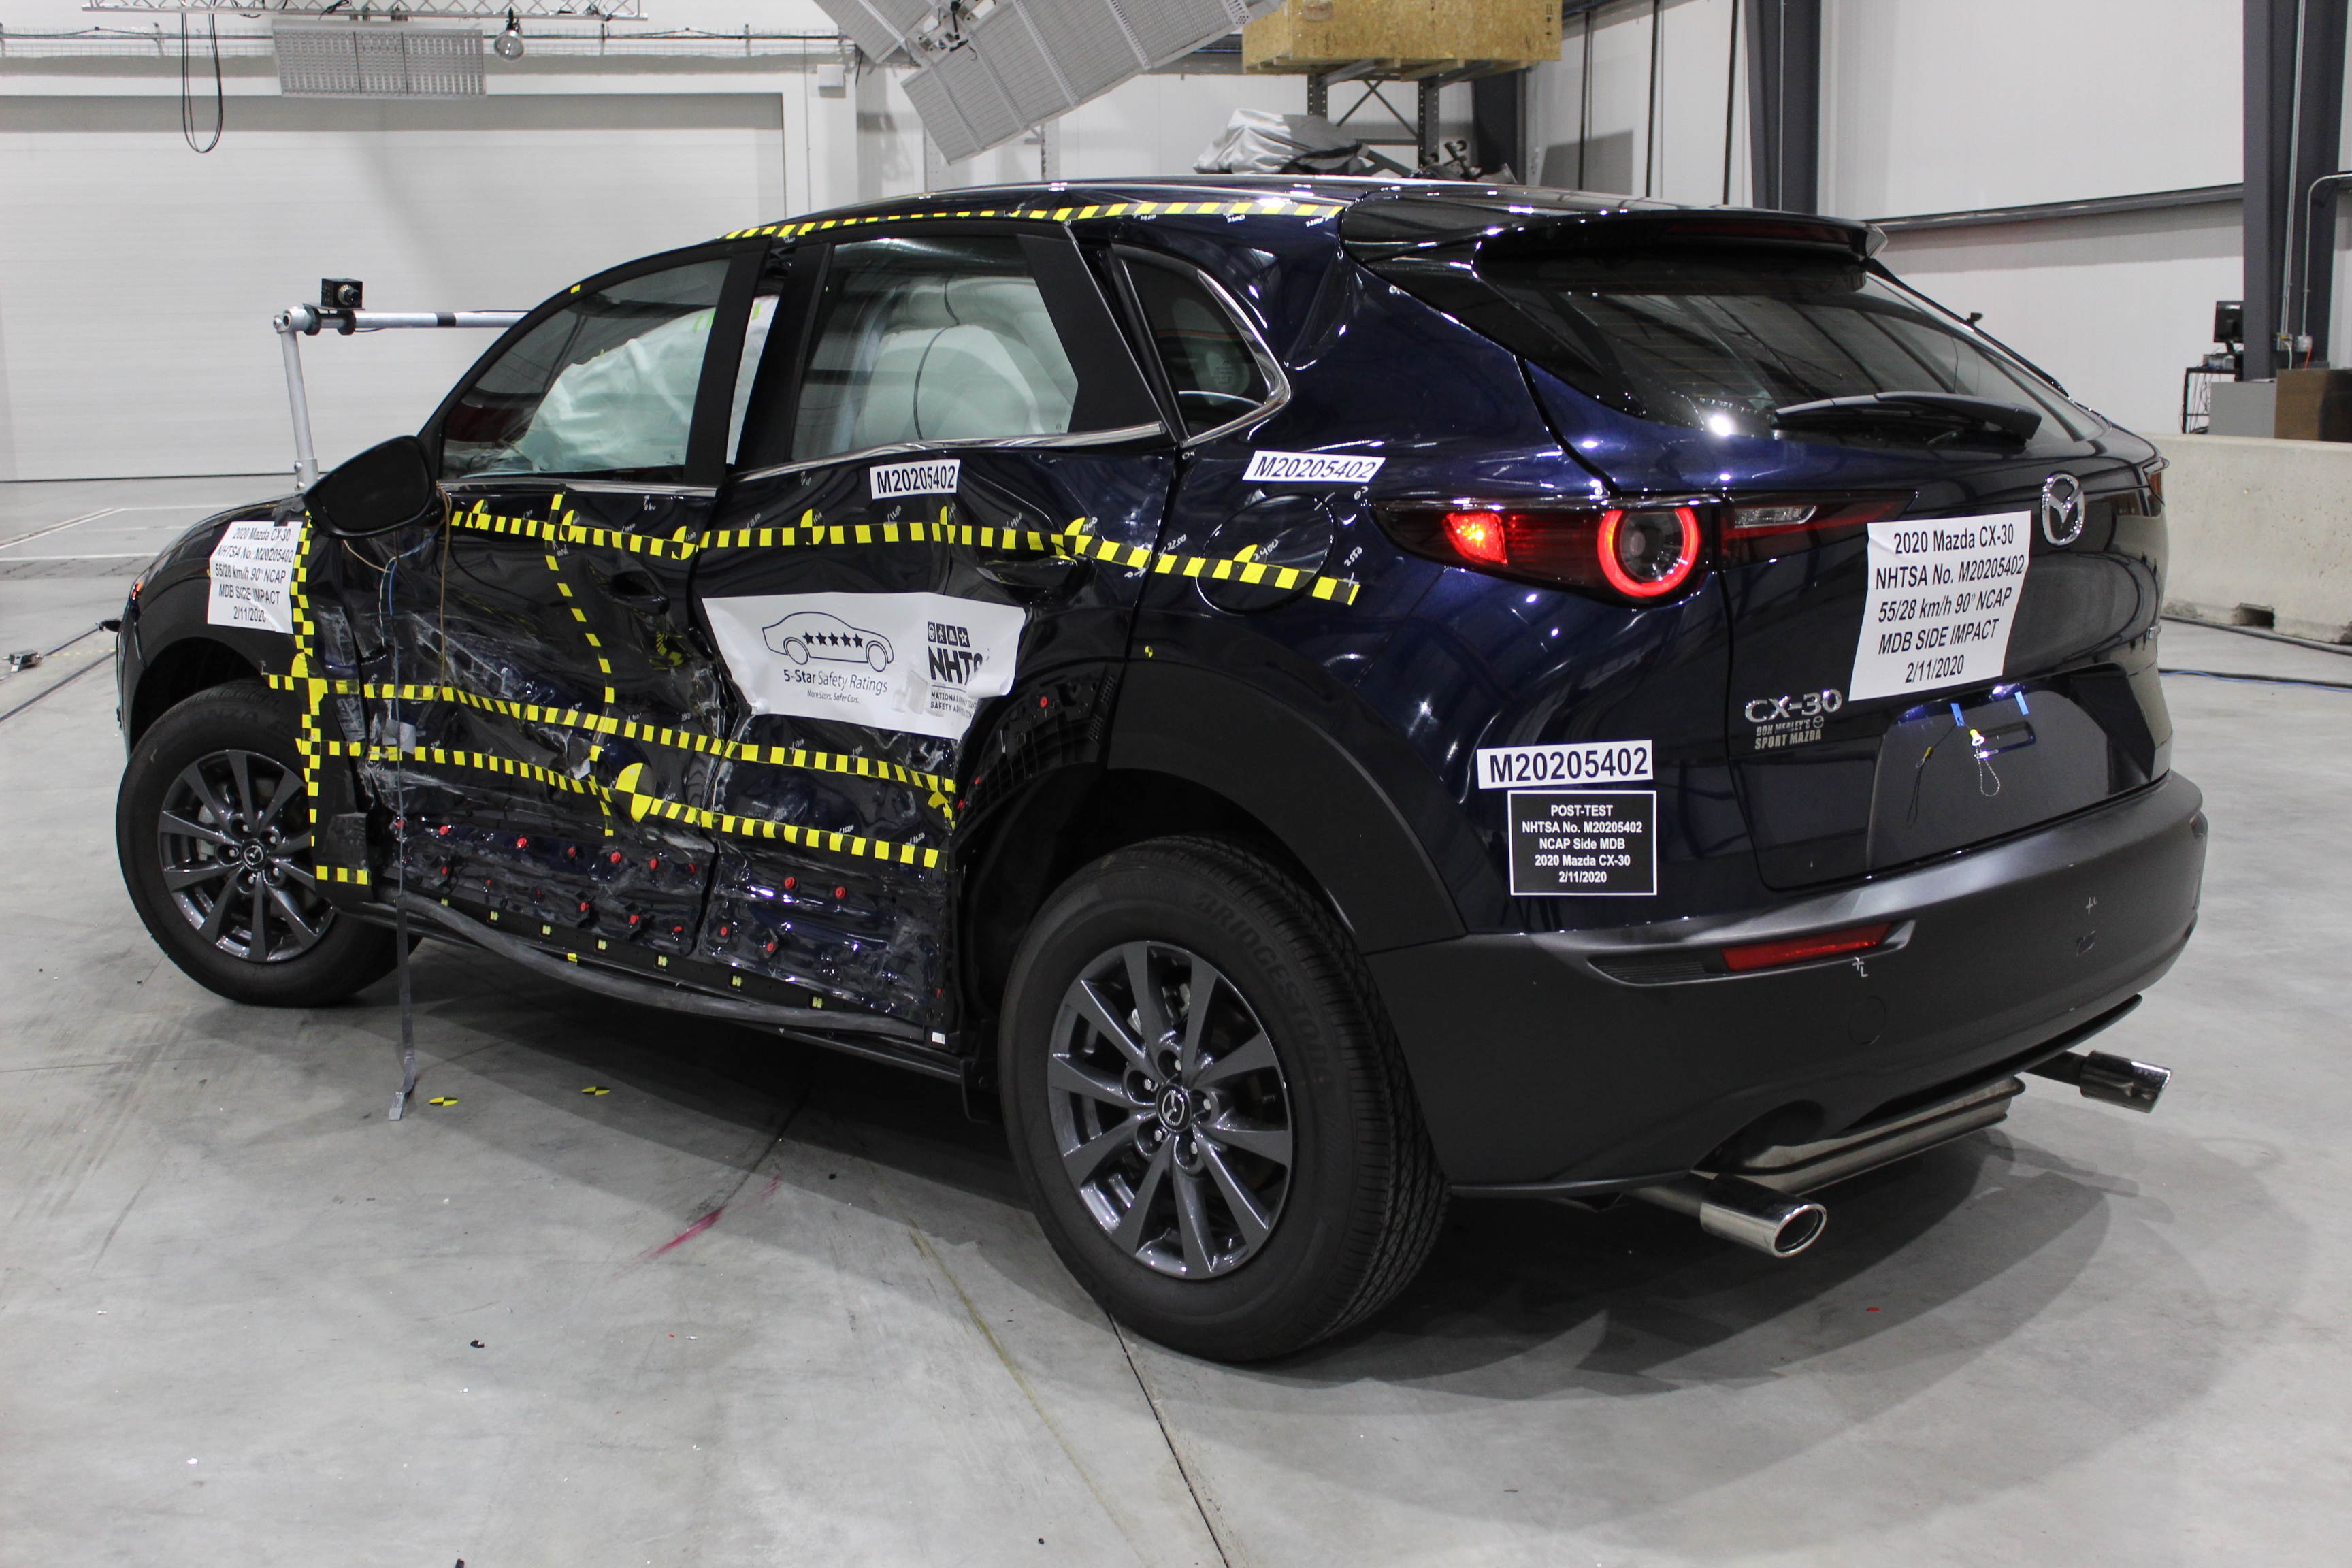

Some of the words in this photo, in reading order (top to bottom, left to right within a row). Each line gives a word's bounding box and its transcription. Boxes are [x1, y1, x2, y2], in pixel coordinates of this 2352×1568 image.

[1254, 455, 1376, 478] M20205402
[877, 466, 956, 494] M20205402
[232, 527, 249, 540] 2020
[248, 528, 270, 541] Mazda
[1166, 534, 1187, 551] 2250
[1894, 530, 1928, 555] 2020
[1933, 528, 1975, 552] Mazda
[1979, 523, 2014, 548] CX-30
[215, 545, 242, 557] NHTSA
[254, 547, 294, 564] M20205402
[1253, 538, 1279, 561] 2400
[215, 563, 231, 578] 55/28
[233, 566, 249, 581] km/h
[263, 569, 287, 584] NCAP
[1876, 565, 1928, 589] NHTSA
[1931, 564, 1954, 586] No.
[1958, 554, 2025, 583] M20205402
[218, 584, 234, 598] MDB
[235, 586, 252, 600] SIDE
[253, 588, 280, 605] IMPACT
[1878, 598, 1917, 623] 55/28
[1919, 595, 1952, 619] km/h
[1976, 587, 2012, 611] NCAP
[233, 606, 266, 623] 2/11/2020
[1878, 631, 1912, 655] MDB
[1916, 626, 1949, 651] SIDE
[1950, 618, 1999, 645] IMPACT
[1905, 654, 1965, 684] 2/11/2020
[783, 668, 816, 684] 5-Star
[818, 670, 848, 691] Safety
[850, 674, 888, 696] Ratings
[807, 689, 819, 699] More
[931, 691, 959, 702] NATIONAL
[930, 701, 952, 712] SAFETY
[1744, 689, 1842, 723] CX-30
[1754, 734, 1788, 750] SPORT
[1789, 729, 1821, 745] MAZDA
[1756, 725, 1773, 736] DON
[1489, 747, 1648, 783] M20205402
[1550, 804, 1614, 817] POST-TEST
[1522, 821, 1561, 834] NHTSA
[1563, 821, 1581, 834] No.
[1583, 821, 1643, 834] M20205402
[1539, 838, 1571, 850] NCAP
[1573, 838, 1597, 850] Side
[1600, 838, 1626, 850] MDB
[1535, 854, 1560, 866] 2020
[1562, 854, 1597, 866] Mazda
[1598, 854, 1631, 866] CX-30
[1558, 870, 1607, 883] 2/11/2020
